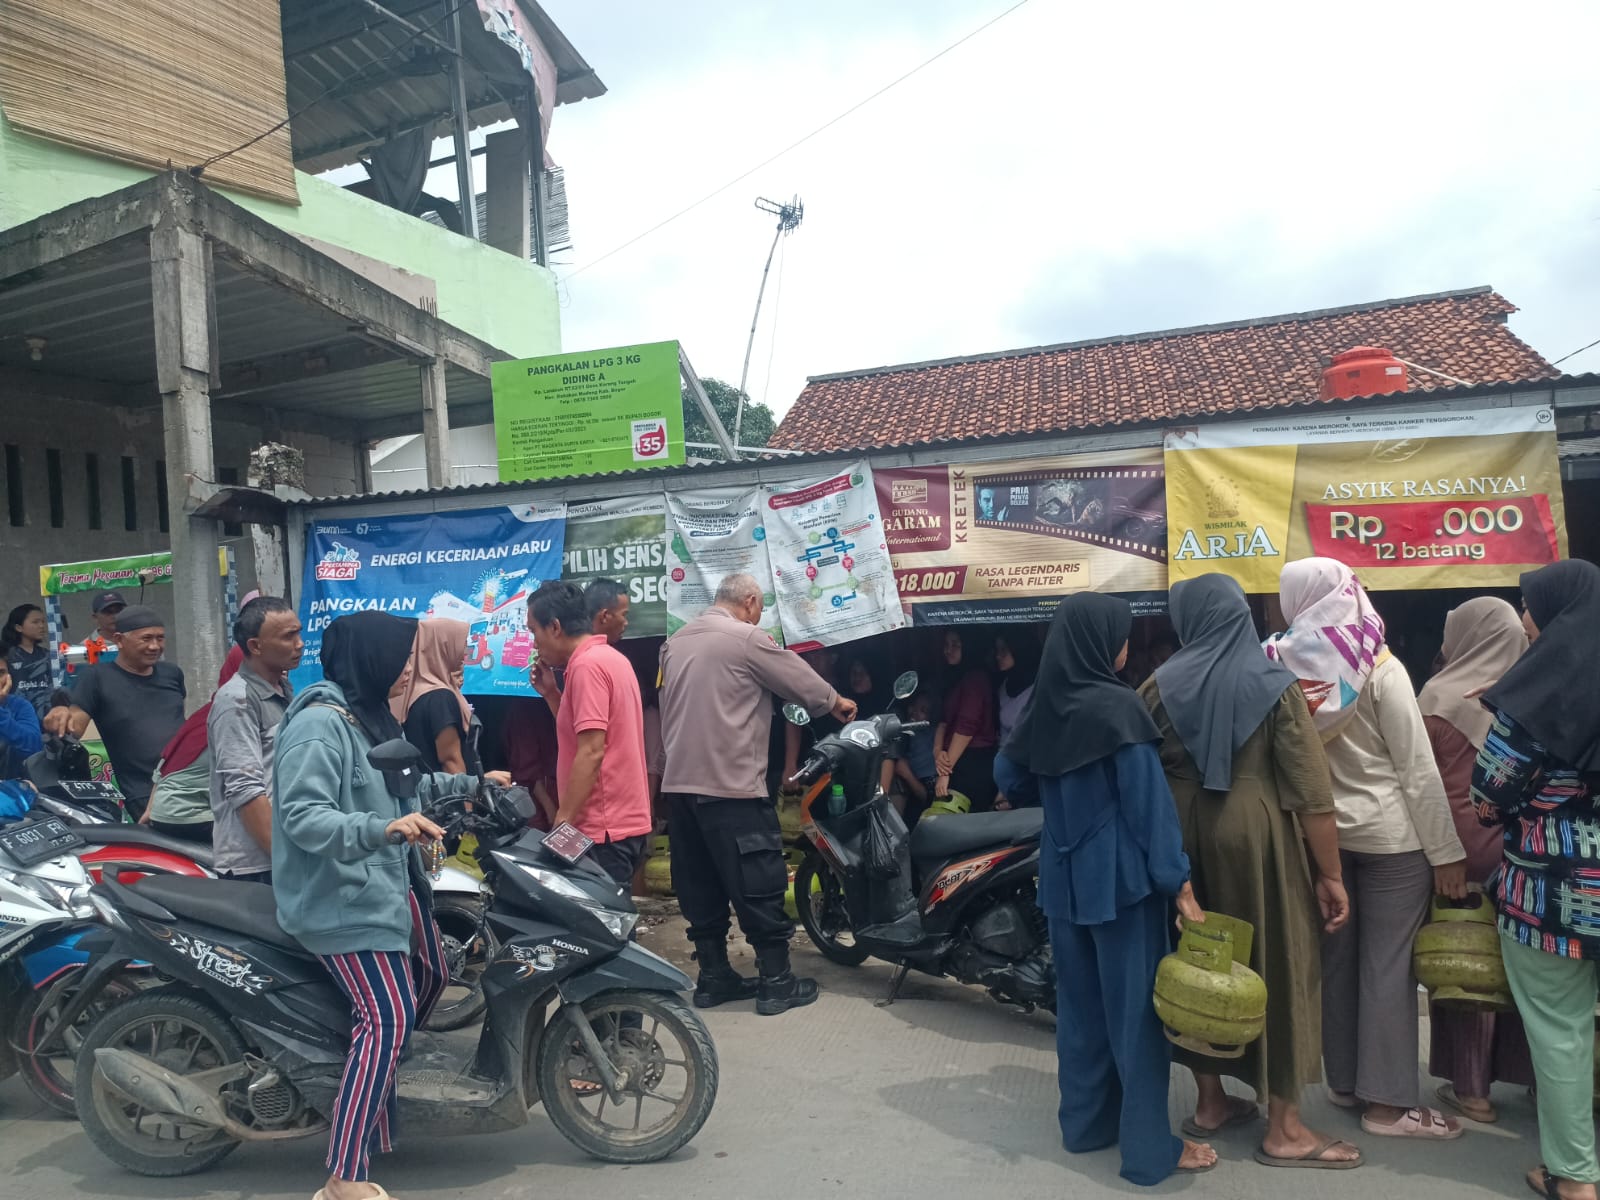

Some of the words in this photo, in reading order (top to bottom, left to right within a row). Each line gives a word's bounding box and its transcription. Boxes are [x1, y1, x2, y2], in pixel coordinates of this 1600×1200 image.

[528, 360, 590, 376] PANGKALAN
[593, 358, 614, 368] LPG
[616, 357, 623, 366] 3
[626, 354, 641, 364] KG
[562, 374, 596, 384] DIDING
[1010, 486, 1029, 494] PRIA
[1321, 481, 1397, 500] ASYIK
[1402, 475, 1527, 497] RASANYA!
[892, 508, 928, 517] GUDANG
[953, 470, 968, 543] KRETEK
[356, 522, 370, 536] 67
[882, 515, 942, 532] GARAM
[1204, 520, 1248, 530] WISMILAK
[1330, 511, 1384, 544] Rp
[1174, 525, 1280, 560] ARJA
[1372, 542, 1396, 560] 12
[1402, 542, 1486, 559] batang
[370, 552, 422, 567] ENERGI
[426, 546, 508, 564] KECERIAAN
[511, 539, 552, 556] BARU
[563, 548, 608, 574] PILIH
[58, 572, 90, 587] Terima
[92, 568, 134, 585] Pesanan
[318, 567, 354, 578] SIAGA
[975, 568, 1004, 577] RASA
[1008, 563, 1080, 576] LEGENDARIS
[988, 578, 1024, 588] TANPA
[1026, 576, 1064, 586] FILTER
[310, 597, 416, 616] PANGKALAN
[307, 614, 332, 632] LPG
[2, 838, 14, 849] F
[16, 828, 45, 844] 6031
[0, 914, 26, 924] NDA
[552, 938, 589, 956] HONDA
[190, 940, 252, 988] Street
